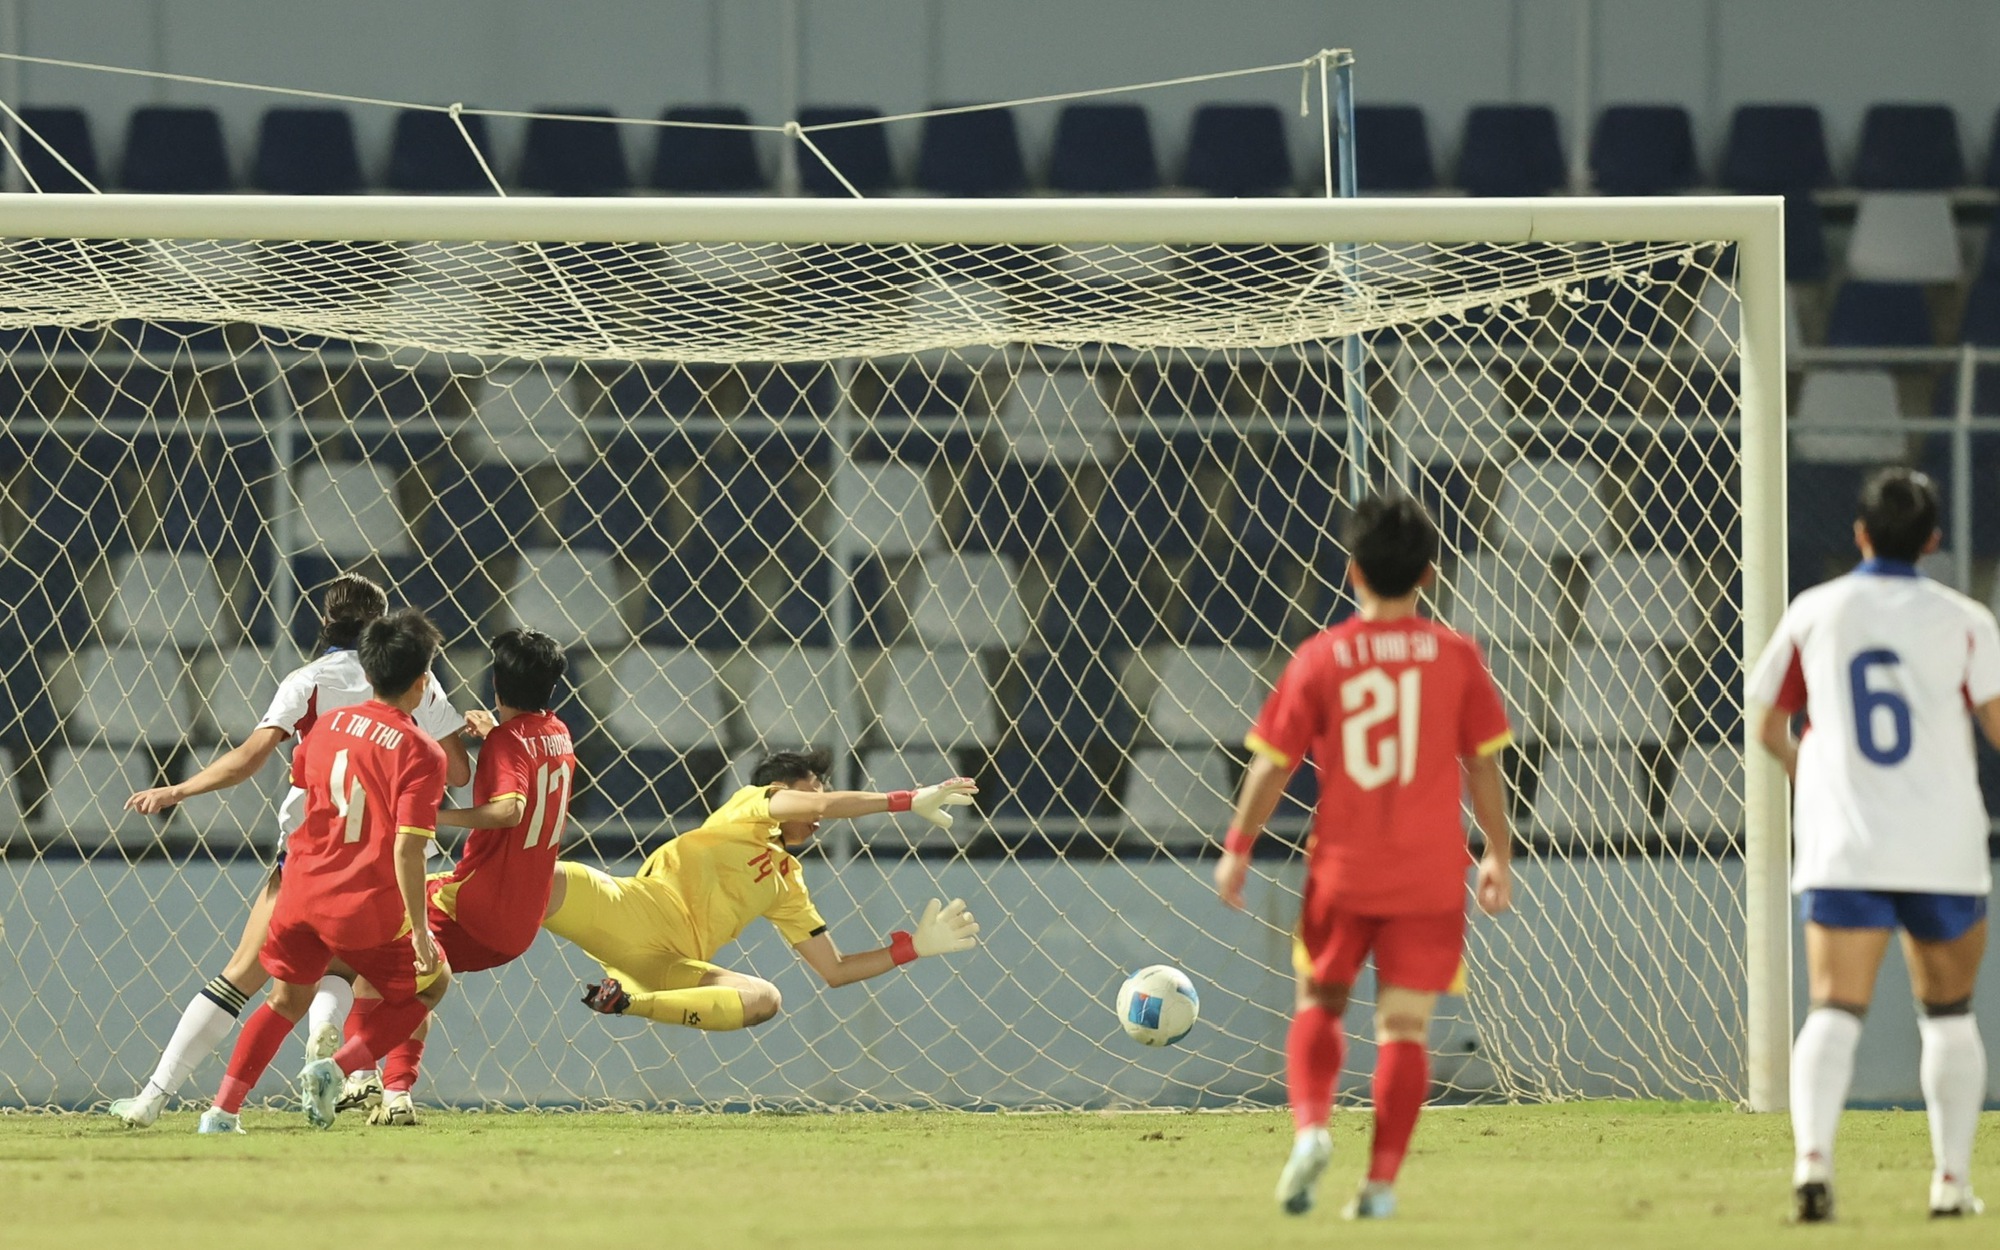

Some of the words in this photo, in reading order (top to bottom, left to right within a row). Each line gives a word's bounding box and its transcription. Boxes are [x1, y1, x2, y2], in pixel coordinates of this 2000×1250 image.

[330, 711, 346, 732] T.
[345, 713, 373, 738] THI
[369, 721, 404, 750] THU
[1341, 667, 1421, 791] 21
[1850, 649, 1911, 766] 6
[329, 748, 367, 844] 4
[523, 760, 571, 849] 17
